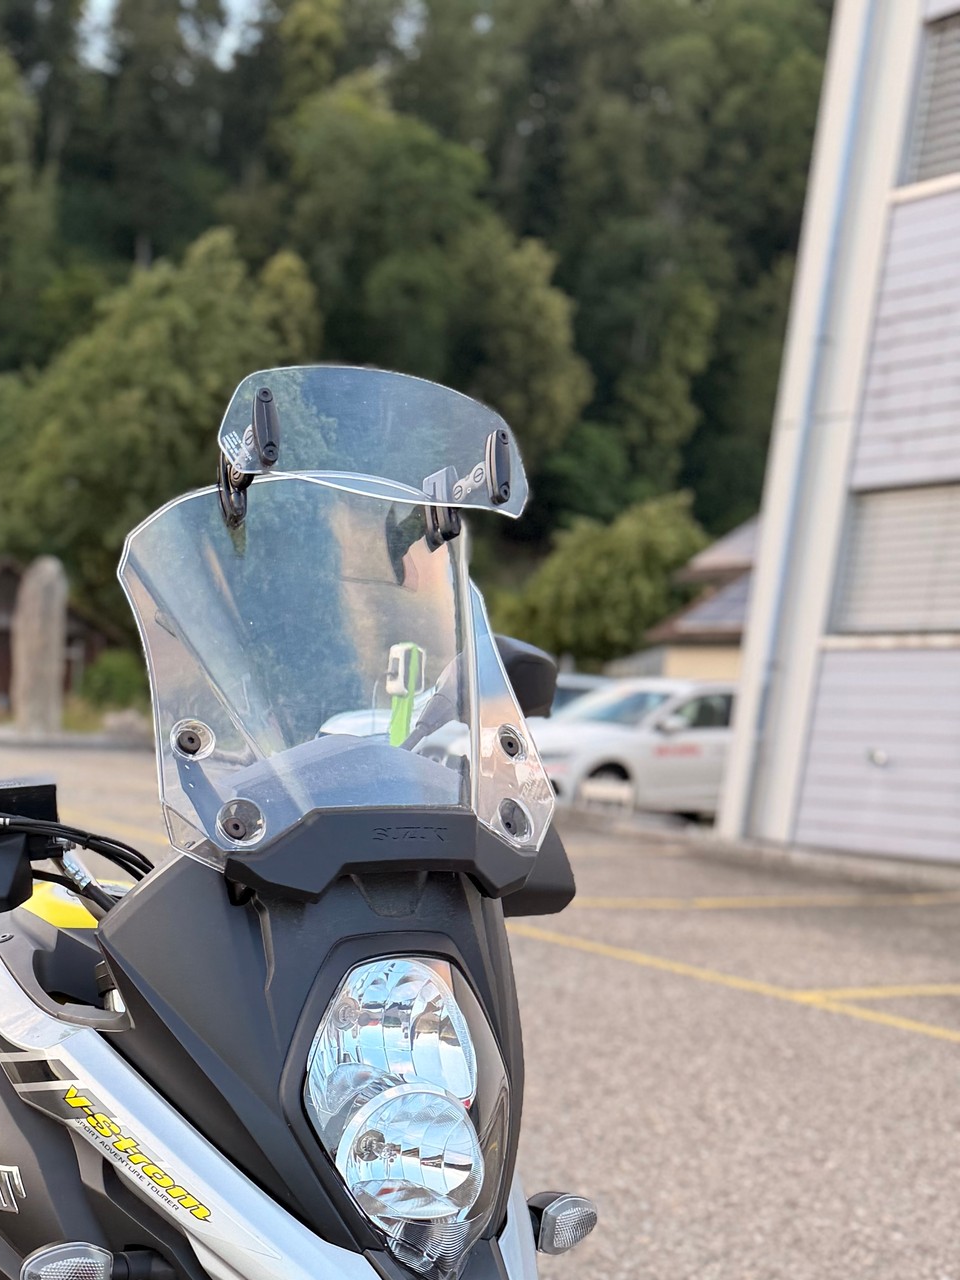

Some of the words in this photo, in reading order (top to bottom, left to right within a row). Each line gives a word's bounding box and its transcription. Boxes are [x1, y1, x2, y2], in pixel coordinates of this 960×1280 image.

[371, 826, 448, 842] SUZUK
[75, 1117, 99, 1141] SPORT
[99, 1140, 145, 1182] ADVENTURE
[147, 1182, 180, 1211] TOURER
